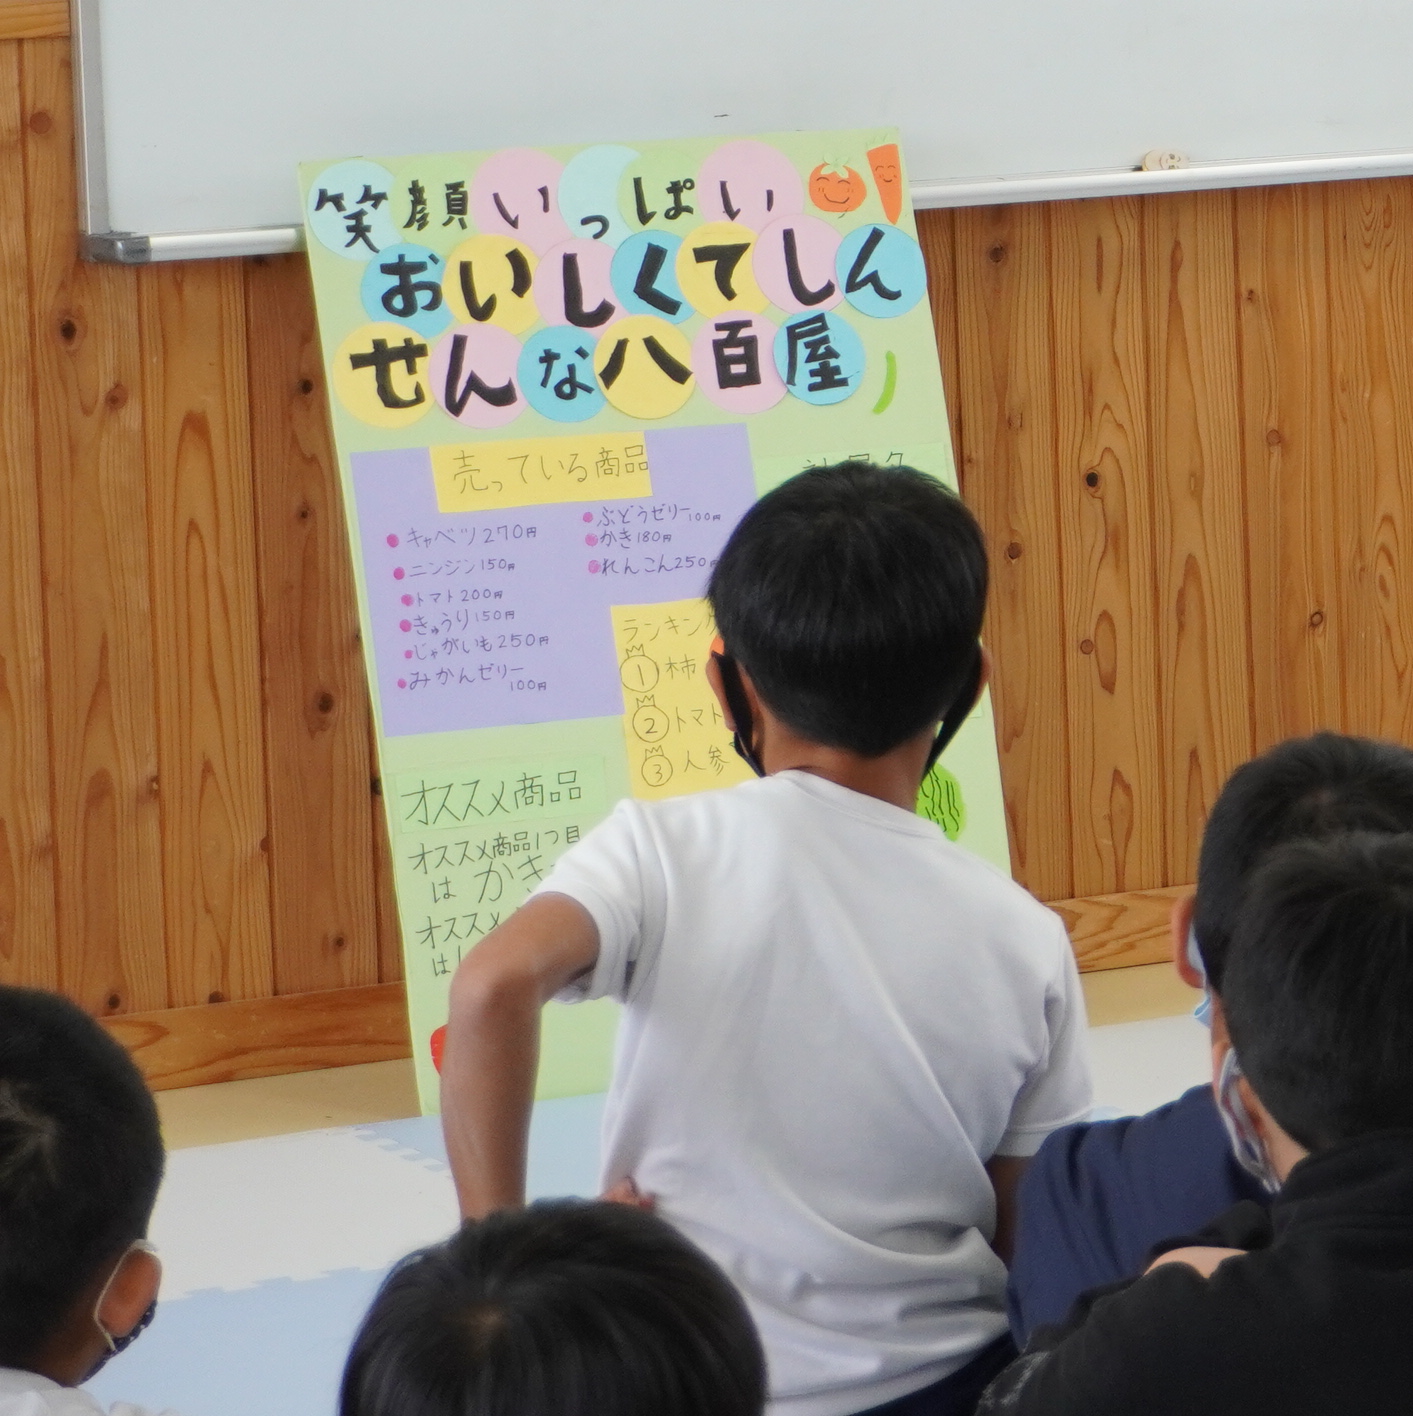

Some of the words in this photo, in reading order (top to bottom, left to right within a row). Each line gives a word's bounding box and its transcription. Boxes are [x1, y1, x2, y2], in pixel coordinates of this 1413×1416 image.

[313, 177, 775, 254] 笑顔いっぱい
[379, 225, 904, 329] おいしくてしん
[349, 312, 851, 418] せんな八百屋
[453, 444, 649, 494] 売っている商品
[406, 526, 537, 548] キャベツ270円
[600, 530, 672, 549] かき180円
[414, 588, 503, 607] トマト200円
[409, 666, 524, 691] みかんゼリー
[665, 656, 696, 680] 柿
[401, 770, 582, 825] オススメ商品
